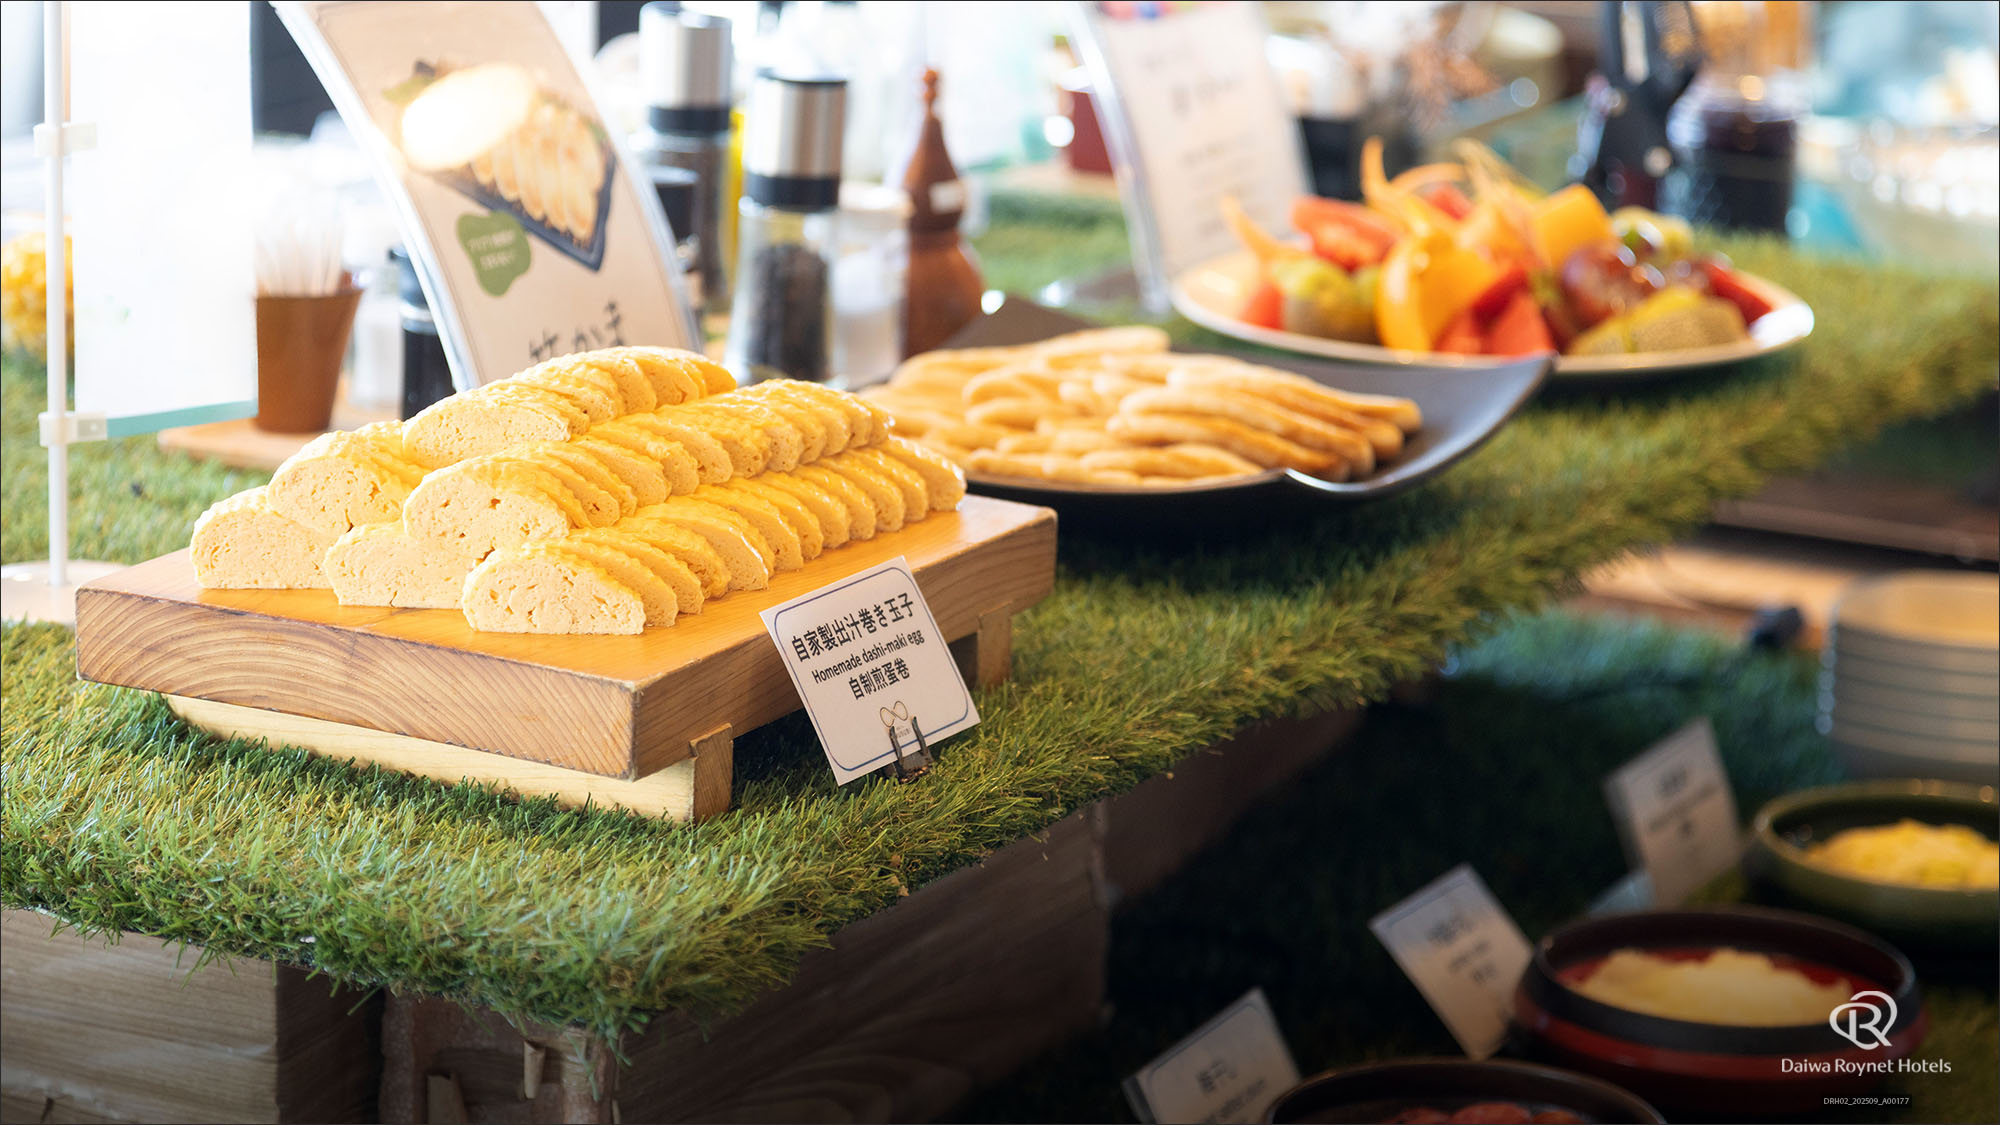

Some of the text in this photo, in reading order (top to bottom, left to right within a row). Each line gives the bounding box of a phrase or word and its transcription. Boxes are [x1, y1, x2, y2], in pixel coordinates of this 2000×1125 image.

[791, 592, 914, 662] 自家製出汁巻き玉子
[811, 630, 925, 684] Homemade dashi-maki egg
[848, 657, 910, 700] 自制煎蛋卷
